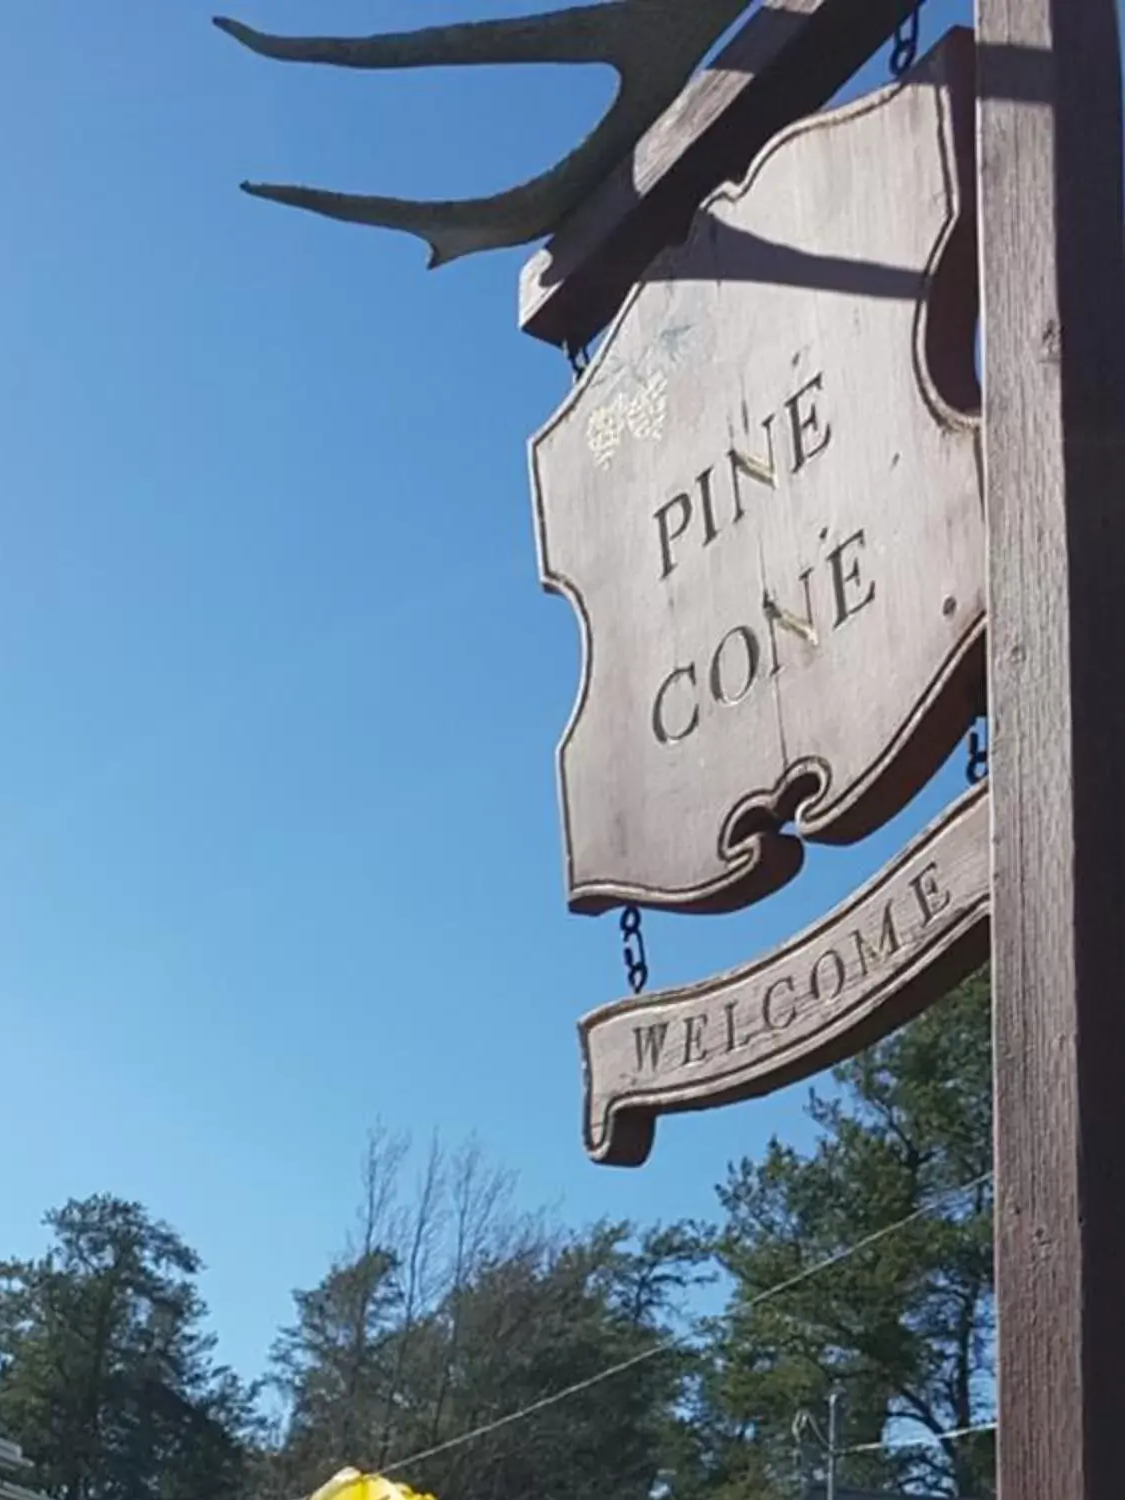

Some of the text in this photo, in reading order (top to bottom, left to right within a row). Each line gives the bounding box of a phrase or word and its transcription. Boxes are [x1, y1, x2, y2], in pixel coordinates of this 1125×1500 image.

[652, 372, 832, 581] PINE
[651, 529, 875, 744] CONE
[632, 861, 952, 1073] WELCOME
